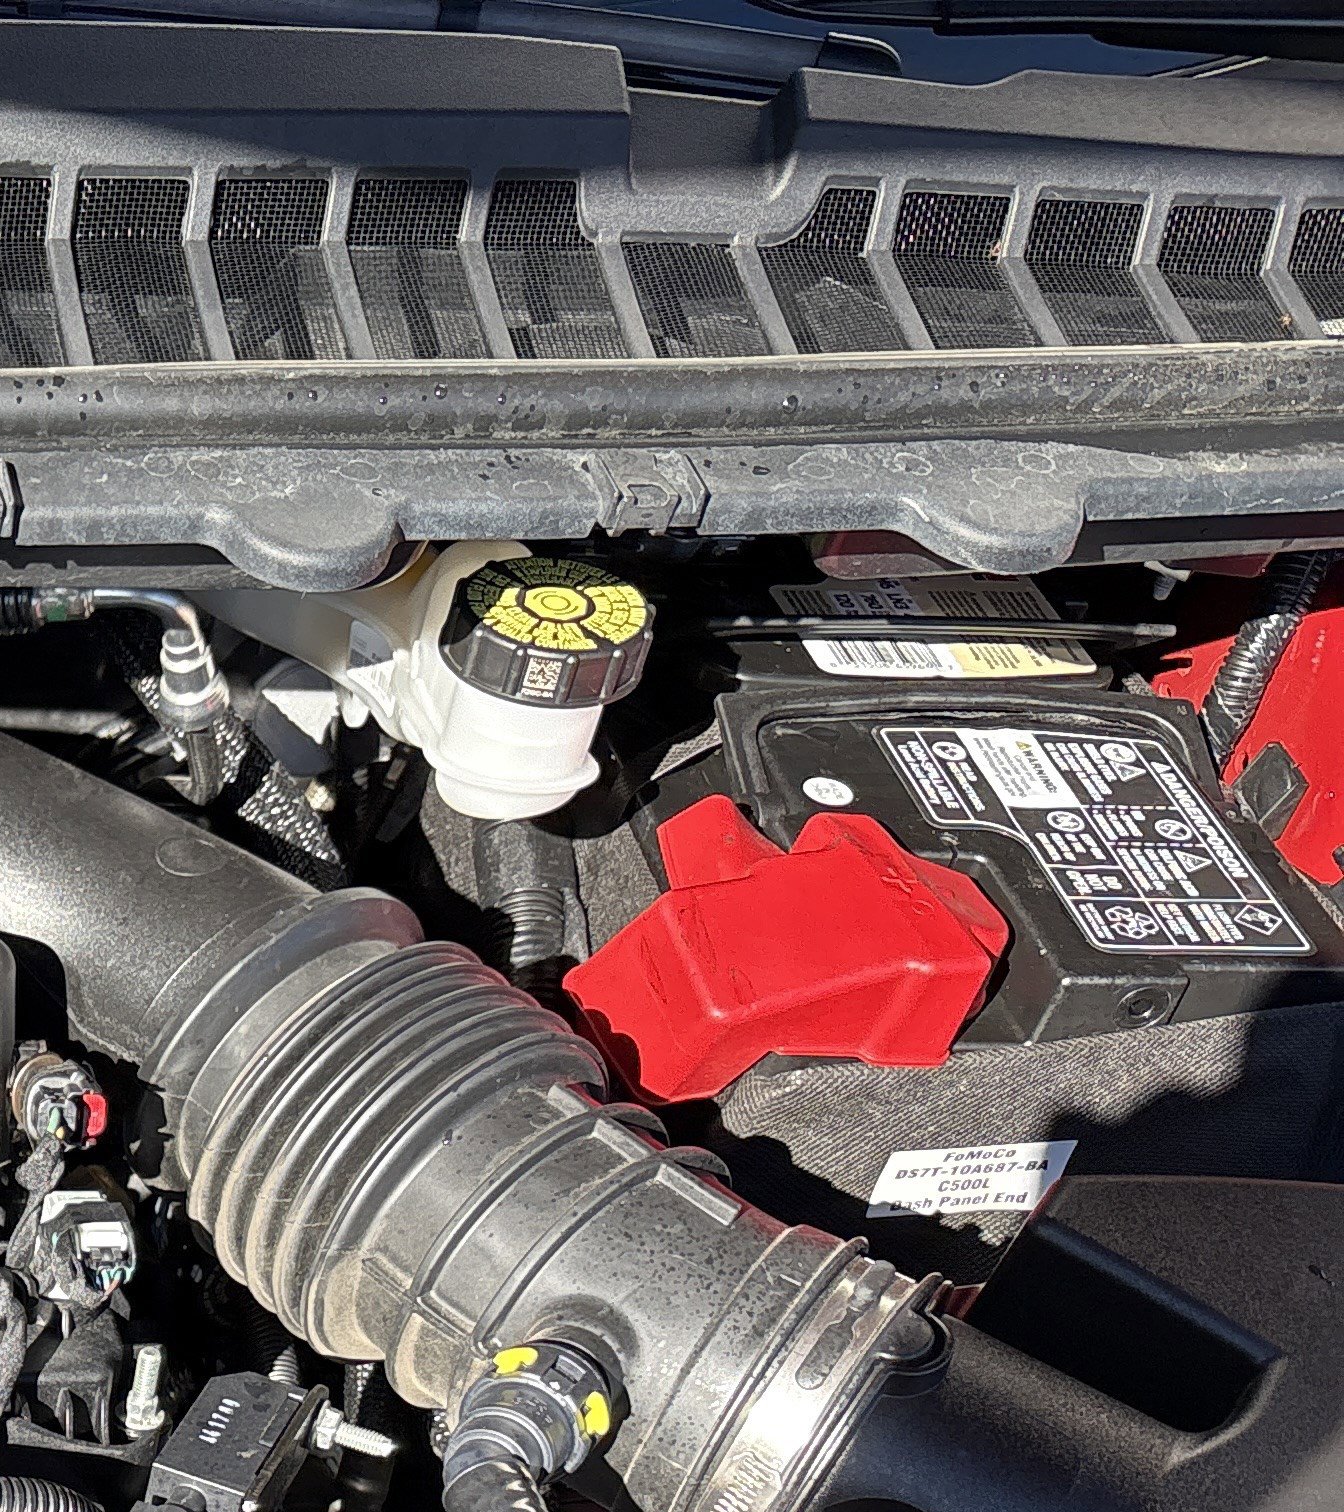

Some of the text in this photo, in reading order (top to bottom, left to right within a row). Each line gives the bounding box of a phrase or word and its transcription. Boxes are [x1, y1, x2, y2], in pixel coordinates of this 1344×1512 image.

[904, 740, 959, 808] NON-SPILLABLE
[1020, 750, 1060, 793] WARNING:
[1156, 772, 1251, 877] DANGER/POISON
[942, 1148, 1017, 1163] FoMoCo
[894, 1159, 1048, 1180] DS7T-10A687-BA
[937, 1177, 991, 1192] C500L
[938, 1193, 987, 1208] Panel
[993, 1191, 1028, 1204] End
